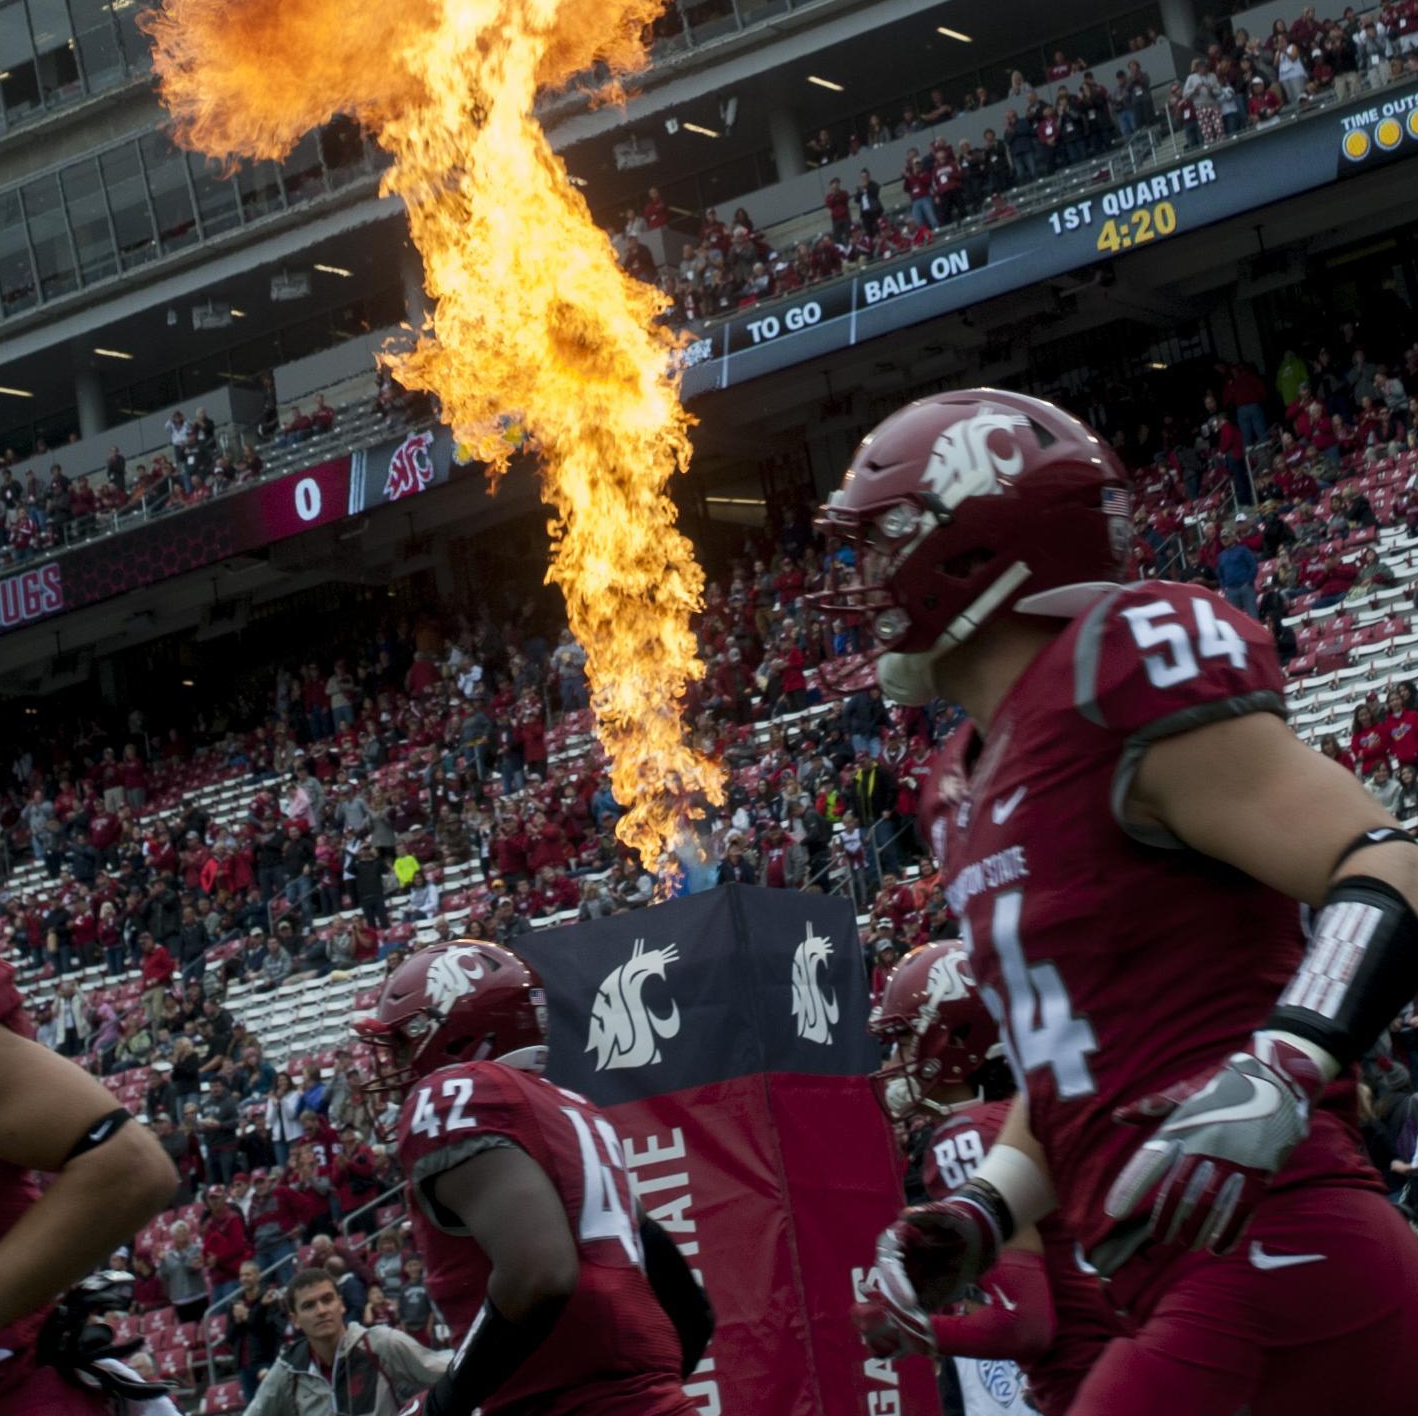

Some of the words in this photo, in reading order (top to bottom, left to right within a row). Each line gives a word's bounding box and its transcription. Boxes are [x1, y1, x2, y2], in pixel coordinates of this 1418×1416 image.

[1341, 108, 1379, 131] TIME
[1048, 201, 1093, 235] 1ST
[1102, 158, 1217, 216] QUARTER
[1096, 201, 1177, 253] 4:20
[864, 266, 927, 304] BALL
[930, 249, 970, 281] ON
[746, 315, 780, 344] TO
[785, 301, 822, 332] GO
[294, 477, 322, 521] 0
[1118, 596, 1250, 691] 54
[410, 1077, 479, 1139] 42
[932, 1129, 985, 1191] 89
[622, 1126, 705, 1289] ATE
[851, 1266, 902, 1416] GAS
